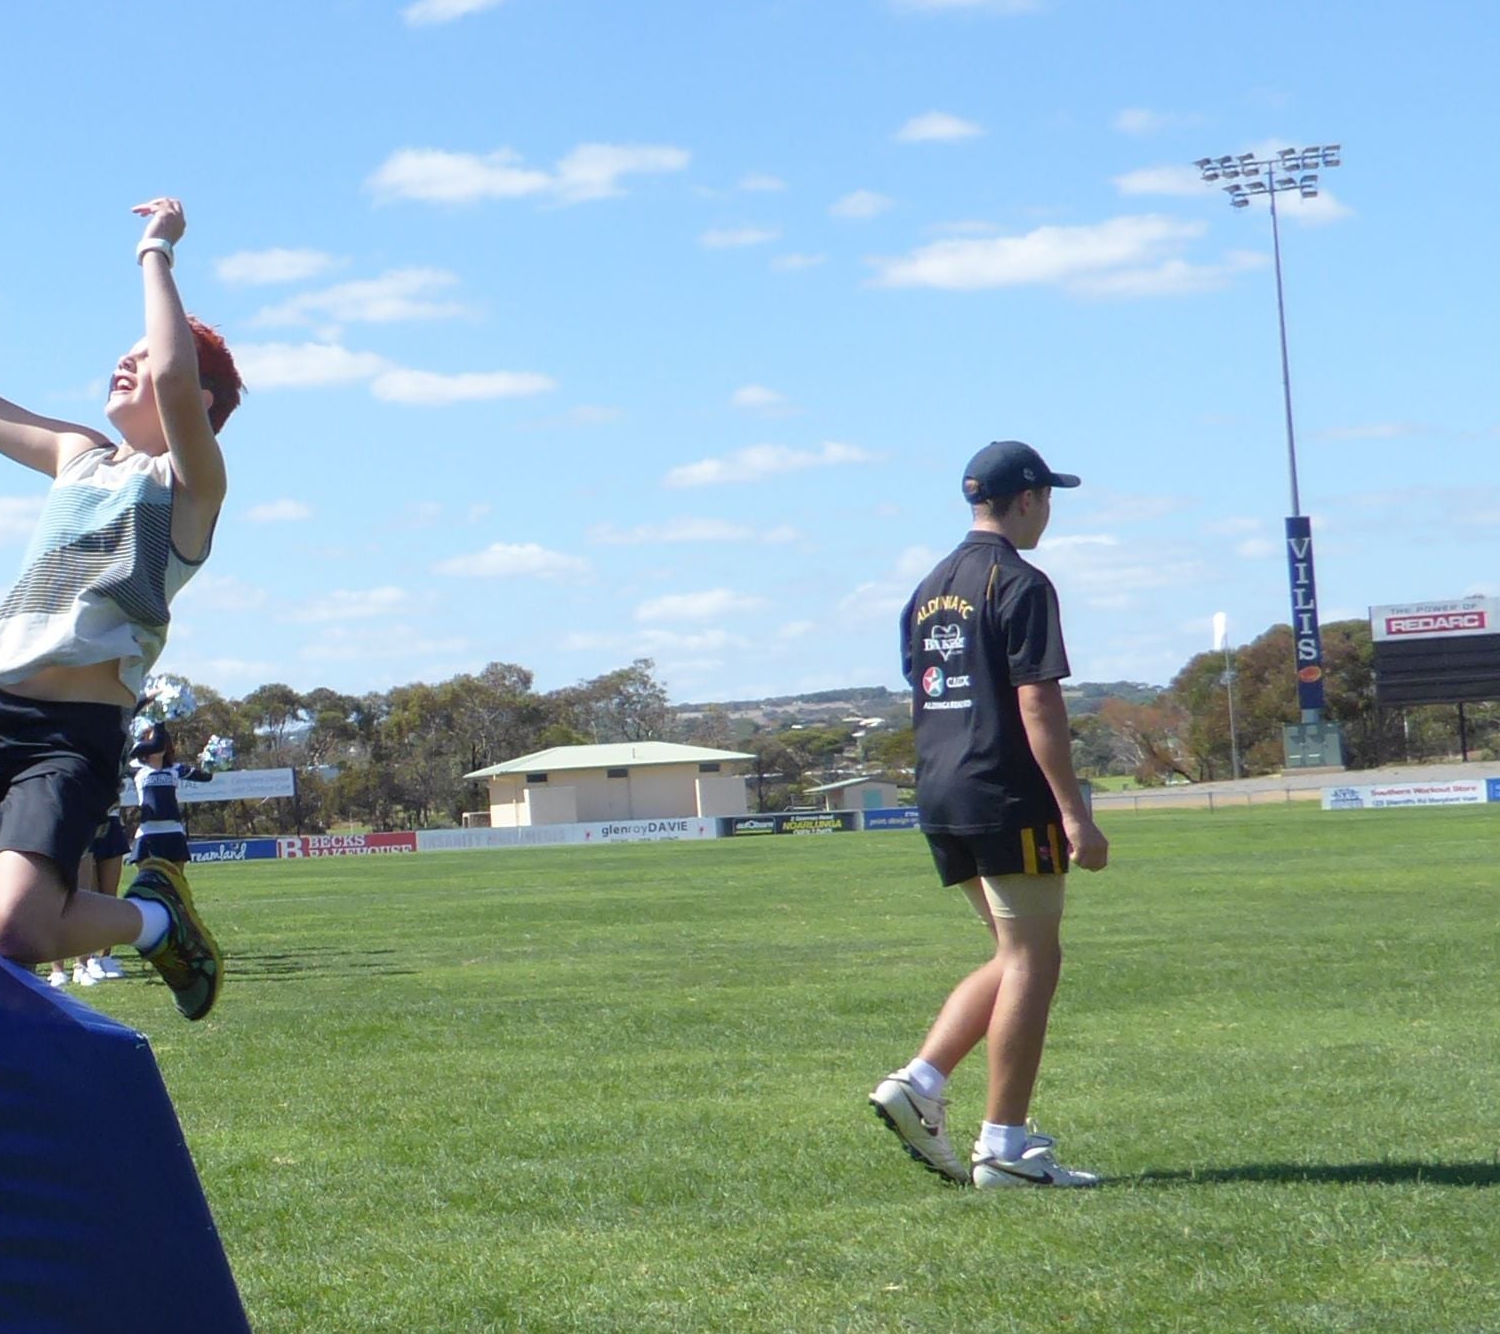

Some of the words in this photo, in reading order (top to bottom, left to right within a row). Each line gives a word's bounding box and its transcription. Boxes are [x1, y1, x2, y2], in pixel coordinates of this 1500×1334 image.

[1288, 537, 1317, 661] VILIS
[1416, 604, 1457, 613] POWER
[1390, 615, 1480, 632] REDARC
[309, 834, 365, 847] BECKS
[190, 842, 247, 862] reamland
[309, 844, 413, 858] BAKEHOUSE
